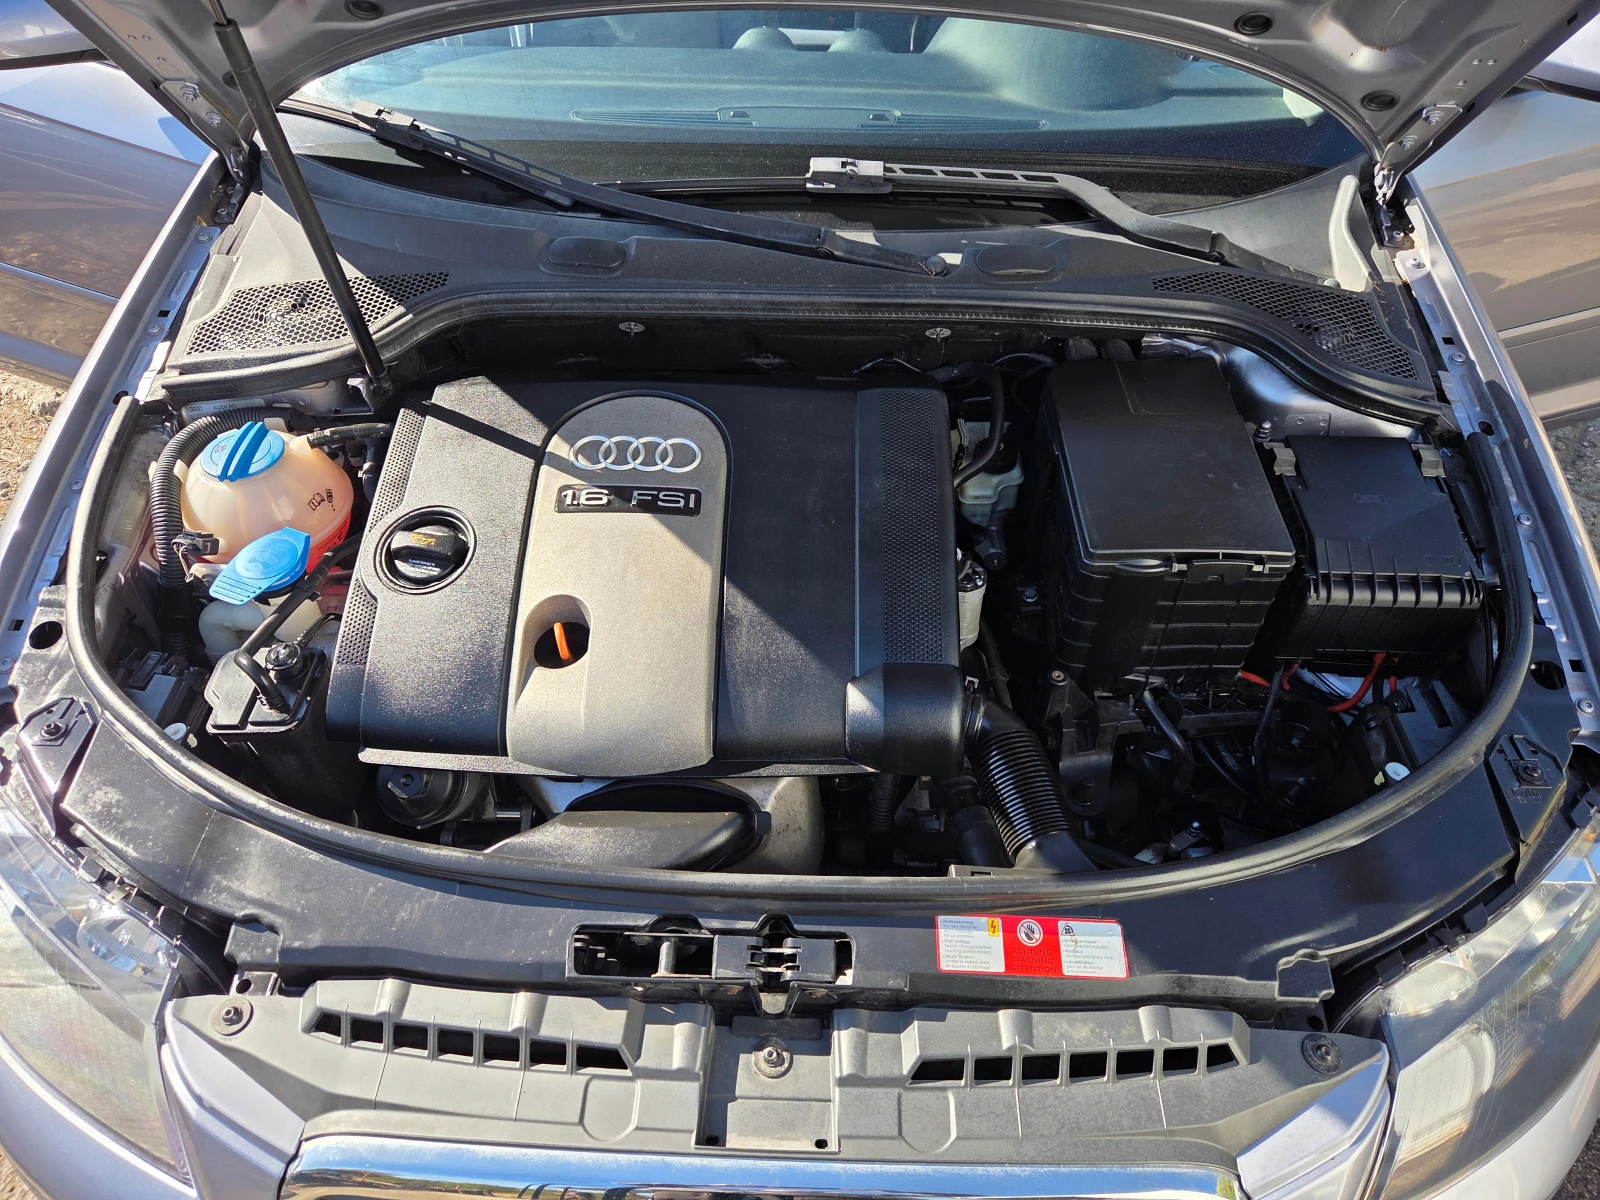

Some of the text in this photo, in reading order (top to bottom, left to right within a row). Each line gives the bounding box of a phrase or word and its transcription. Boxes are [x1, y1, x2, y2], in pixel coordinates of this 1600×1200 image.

[562, 490, 696, 510] 1.6 FSI
[1011, 956, 1054, 964] WARNING
